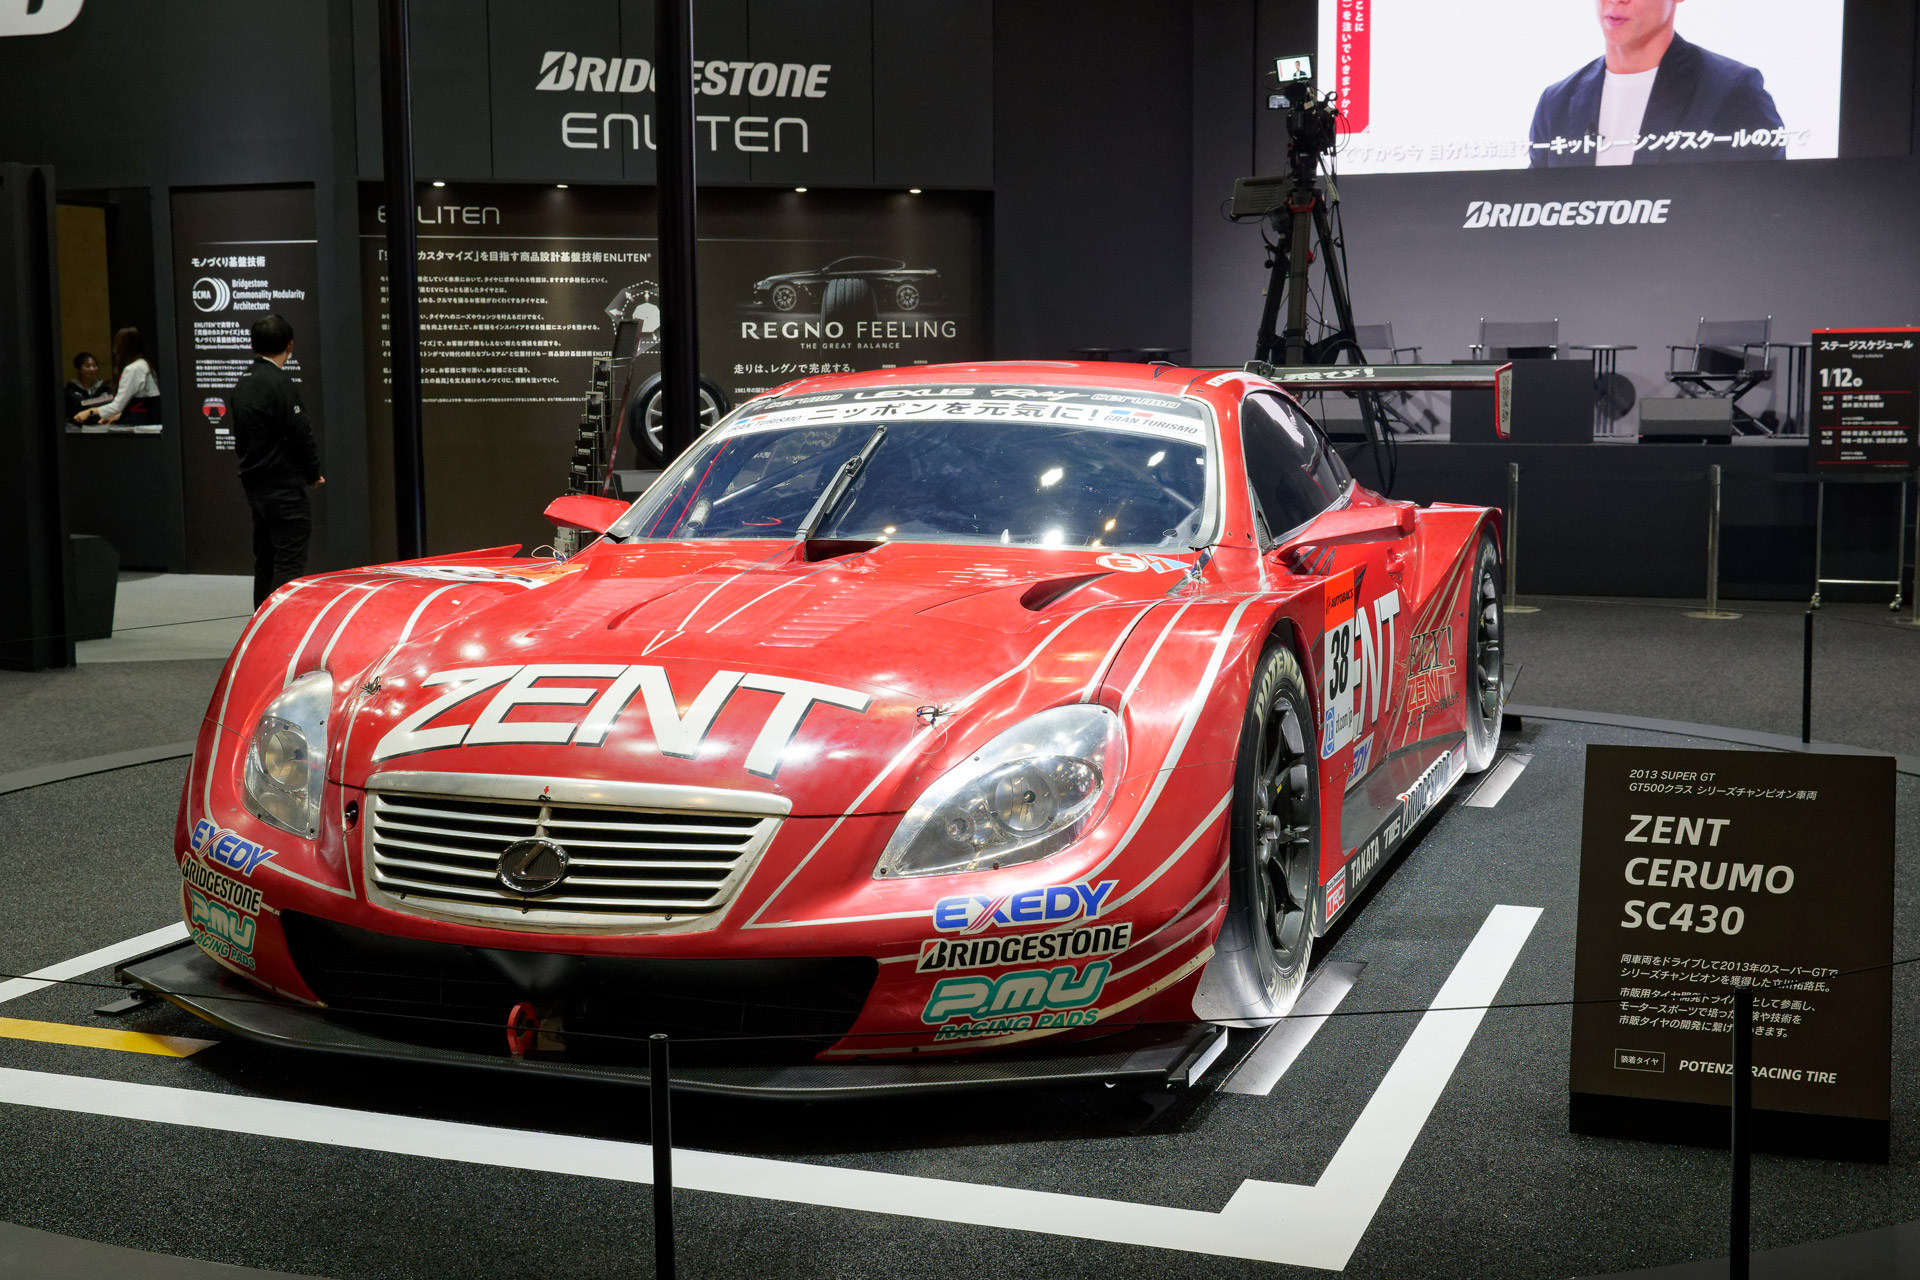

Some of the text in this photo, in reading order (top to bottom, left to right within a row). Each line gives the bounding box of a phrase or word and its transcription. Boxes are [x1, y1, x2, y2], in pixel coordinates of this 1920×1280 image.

[1462, 199, 1672, 228] BRIDGESTONE
[191, 256, 266, 268] モノづくり基盤技術
[192, 290, 212, 300] BCMA
[232, 279, 269, 289] Bridgestone
[232, 289, 305, 301] Commonality Modularity
[233, 301, 270, 311] Architecture
[741, 320, 957, 340] REGNO FEELING
[800, 342, 900, 350] THE GREAT BALANCE
[1820, 340, 1914, 351] ステージスケジュール
[734, 363, 856, 375] 走りは、レグノで完成する。
[854, 388, 975, 400] LEXUS
[807, 402, 1099, 422] ニッポンを元気に!
[1103, 414, 1198, 434] GRAN TURISMO
[1329, 624, 1350, 701] 38
[1408, 625, 1456, 677] FLY!
[1407, 665, 1457, 712] ZENT
[371, 662, 875, 781] ZENT
[1629, 769, 1716, 782] 2013 SUPER GT
[1629, 782, 1819, 801] GT500クラス シリーズチャンピオン車両
[1624, 814, 1731, 847] ZENT
[191, 820, 276, 875] EXEDY
[1351, 836, 1380, 888] TAKATA
[182, 854, 262, 914] BRIDGESTONE
[1624, 857, 1795, 895] CERUMO
[935, 881, 1115, 931] EXEDY
[1621, 900, 1745, 936] SC430
[191, 928, 256, 969] RACING PADS
[919, 924, 1129, 971] BRIDGESTONE
[933, 1009, 1100, 1041] RACING PADS
[1620, 1055, 1660, 1066] 装着タイヤ
[1679, 1059, 1838, 1084] POTENZ RACING TIRE
